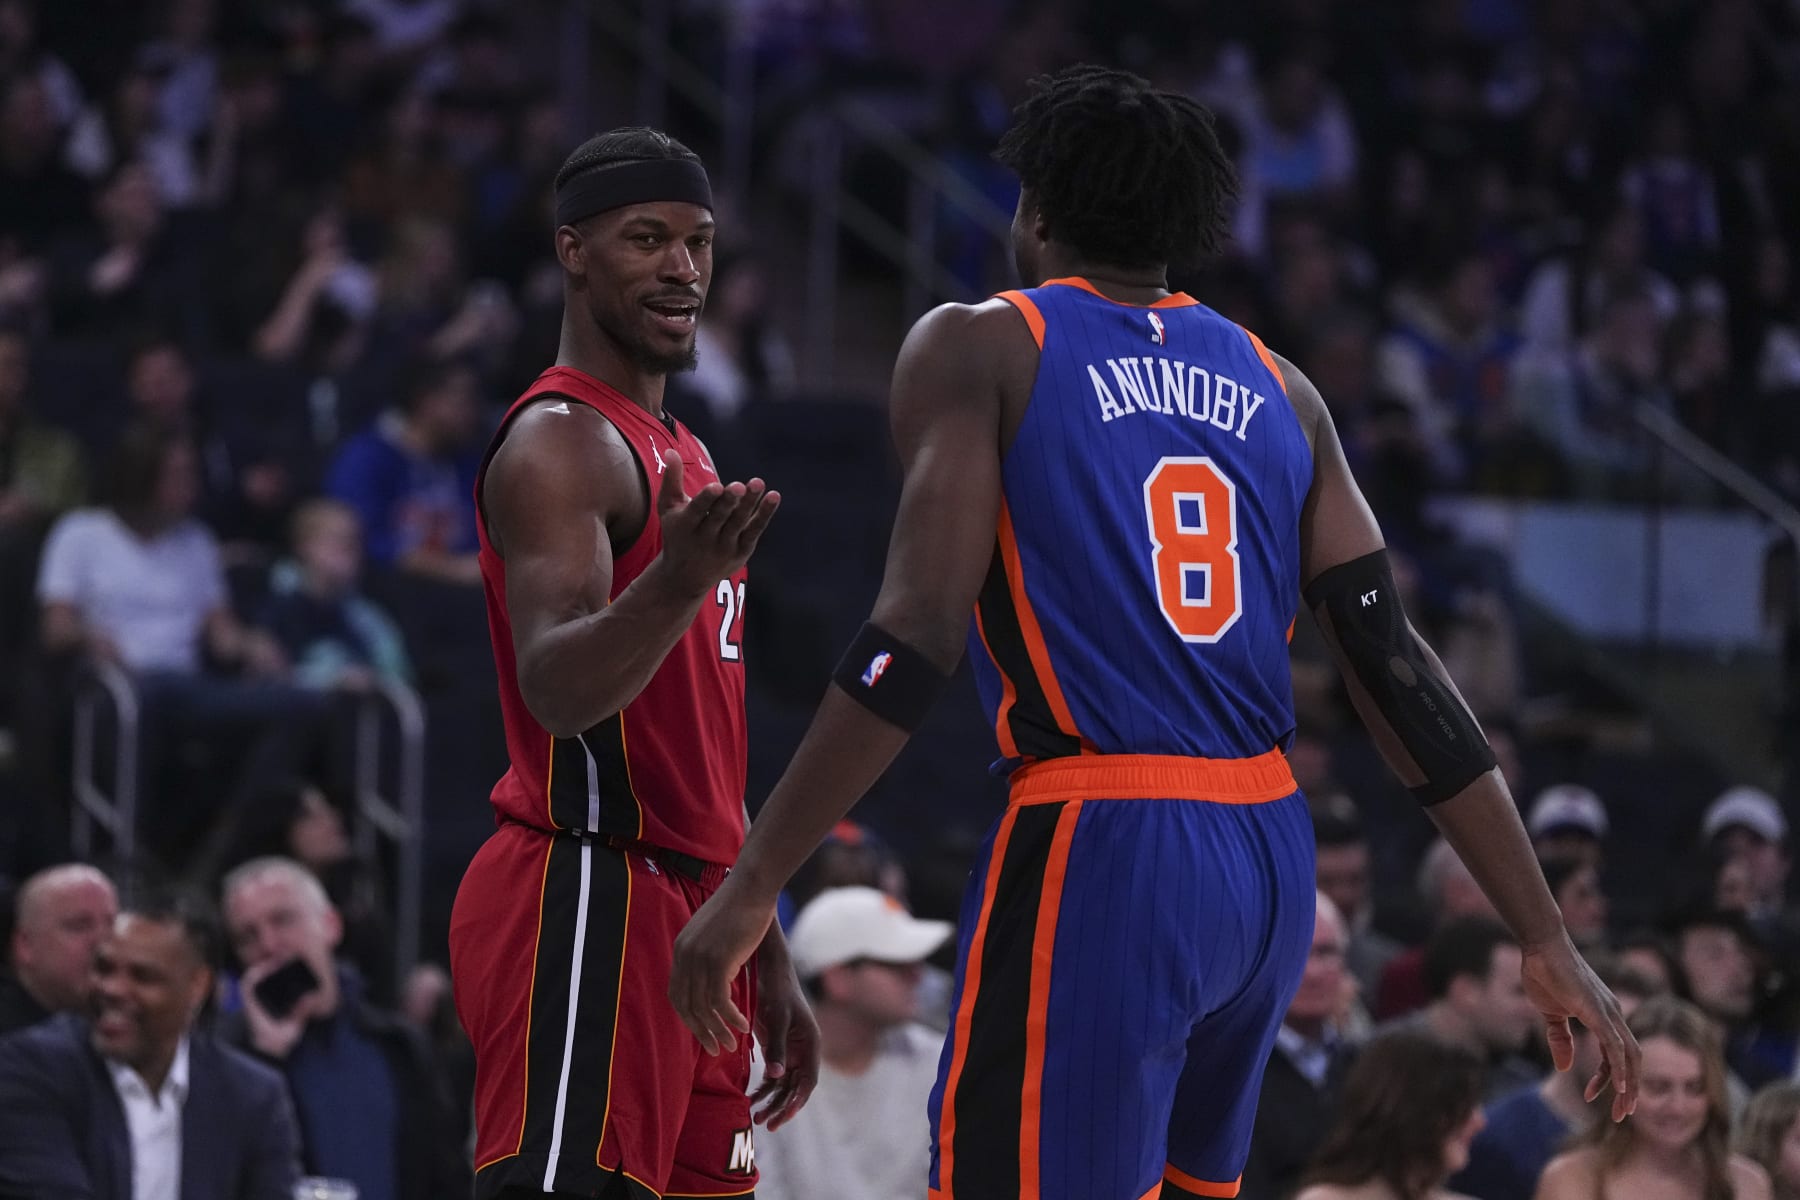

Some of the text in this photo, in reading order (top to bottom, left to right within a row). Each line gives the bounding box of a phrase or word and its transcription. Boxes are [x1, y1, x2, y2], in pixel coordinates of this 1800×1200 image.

[1087, 357, 1265, 441] ANUNOBY
[1143, 456, 1243, 644] 8
[1361, 589, 1378, 607] KT
[1420, 691, 1457, 741] PRO WIDE
